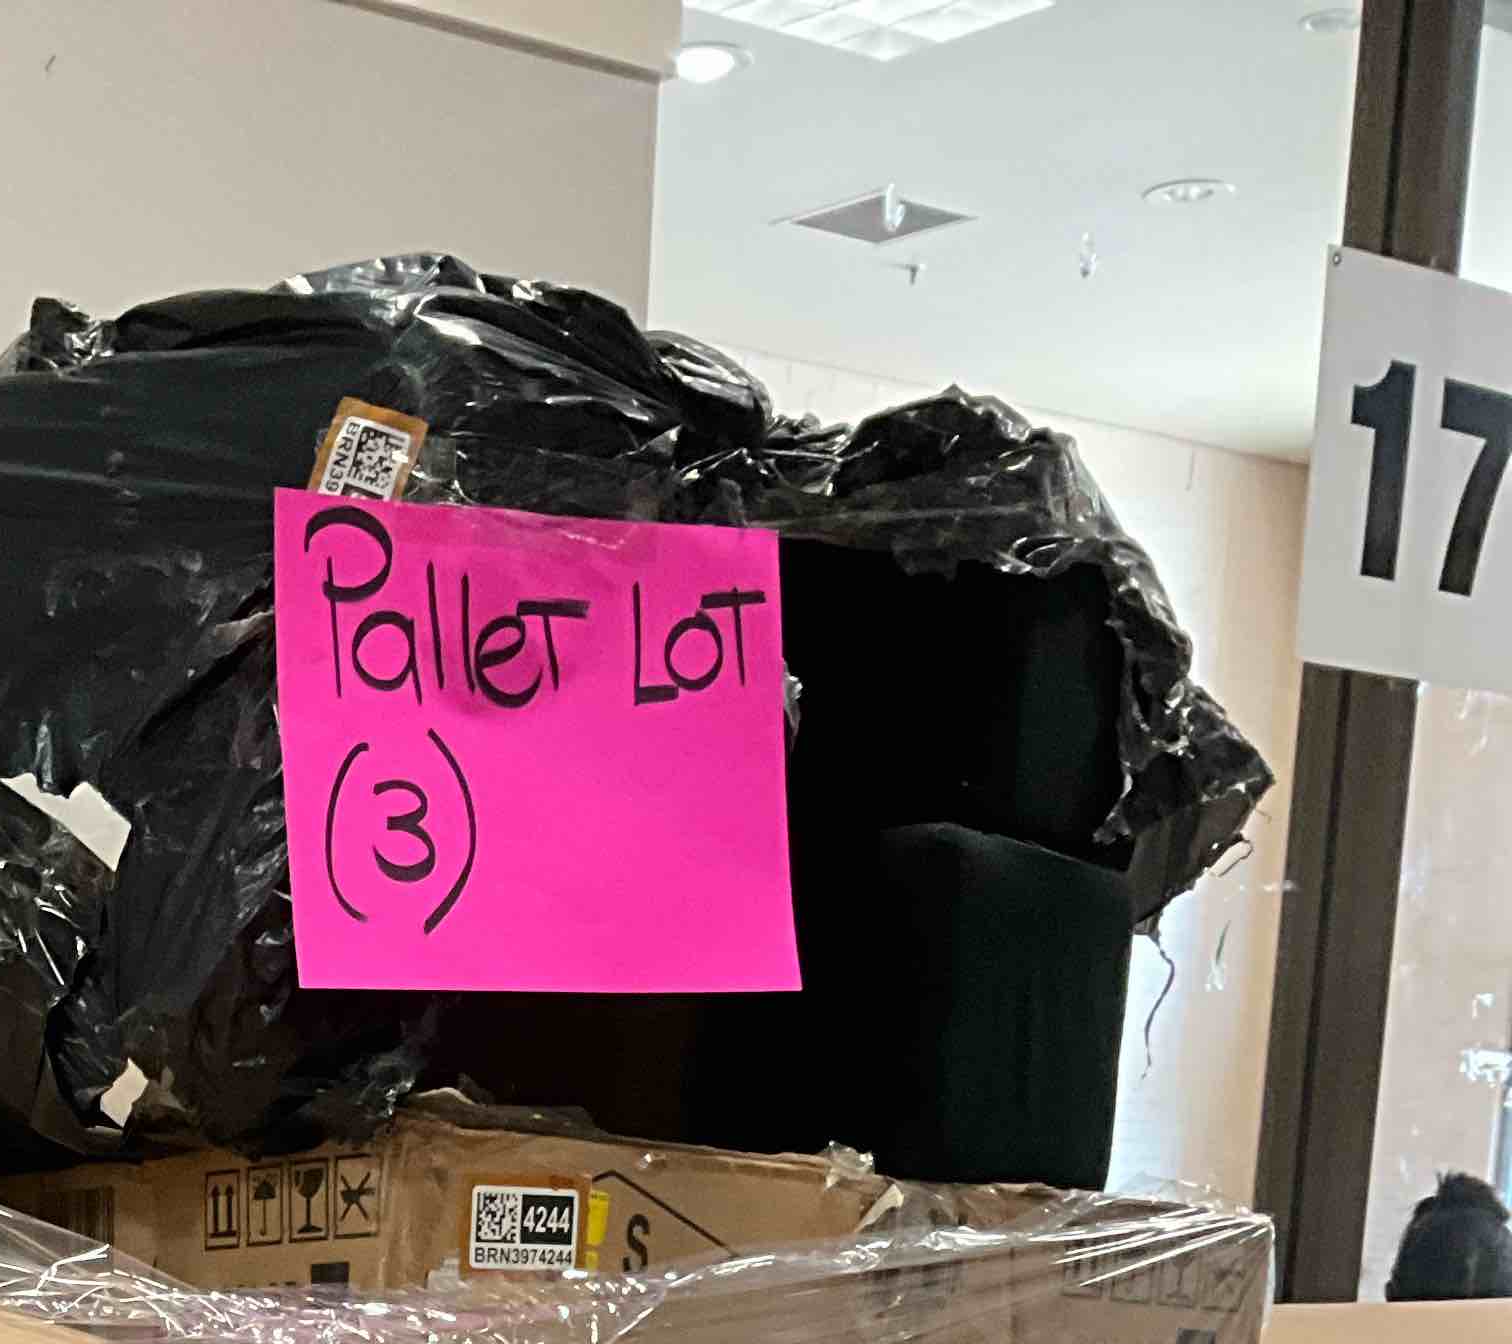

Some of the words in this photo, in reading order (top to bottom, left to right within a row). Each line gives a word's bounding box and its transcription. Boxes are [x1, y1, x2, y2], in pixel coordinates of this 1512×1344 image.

[1351, 360, 1512, 597] 17
[325, 727, 477, 935] (3)
[473, 1246, 573, 1266] BRN3974244
[522, 1205, 570, 1234] 4244
